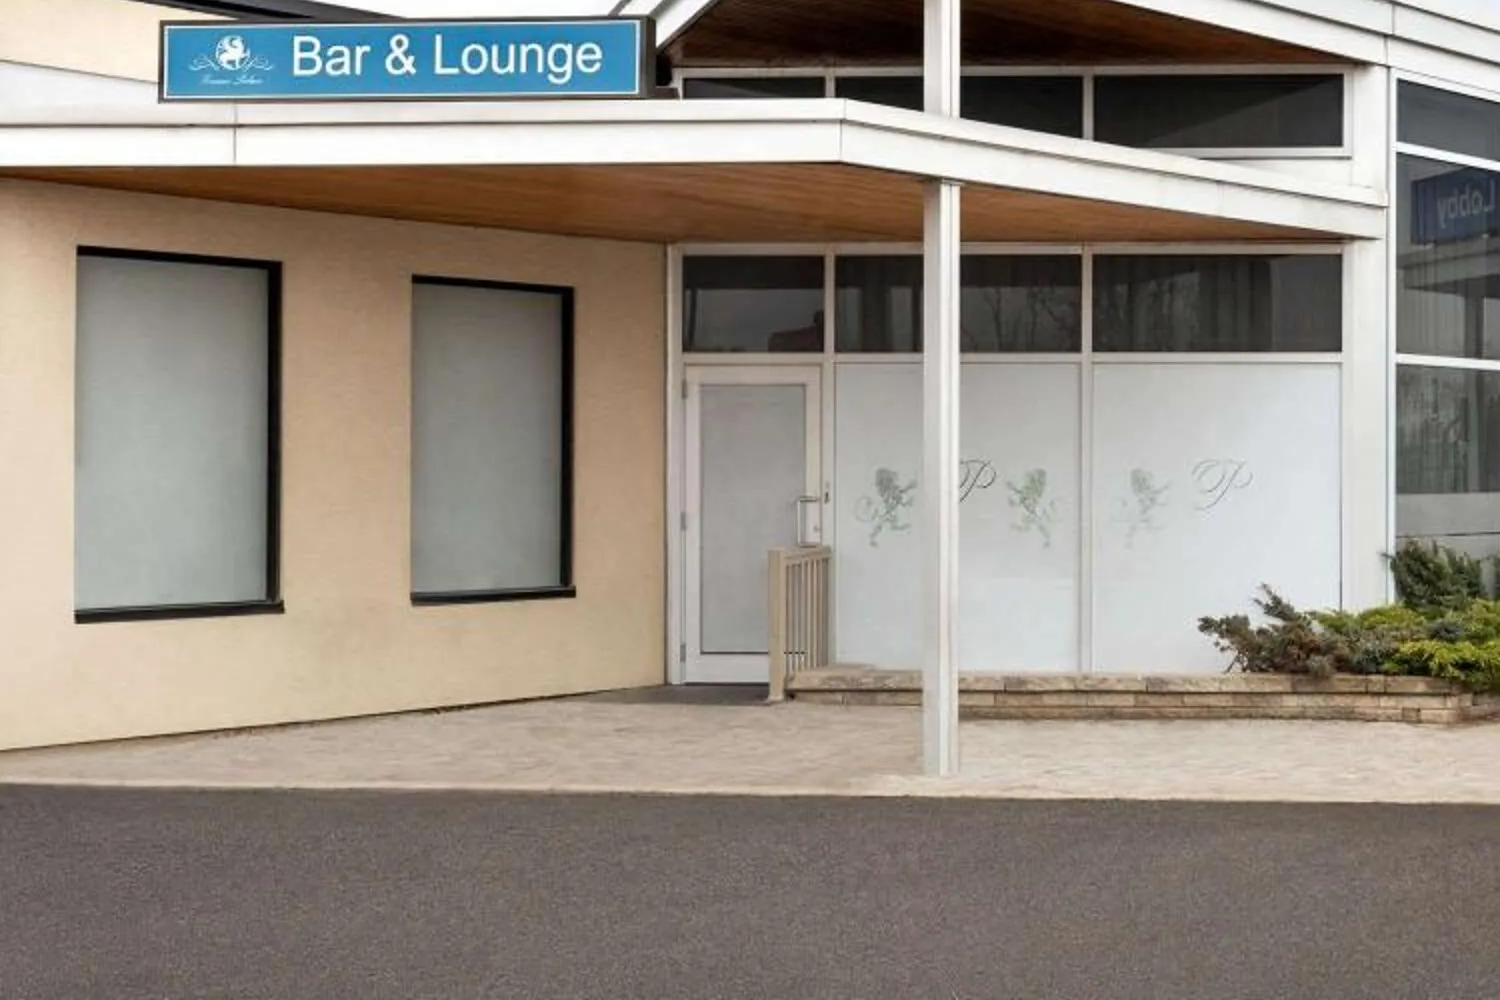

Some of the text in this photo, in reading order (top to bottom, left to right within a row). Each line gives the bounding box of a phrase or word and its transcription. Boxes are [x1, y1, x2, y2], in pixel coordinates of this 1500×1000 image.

[292, 33, 602, 83] Bar & Lounge
